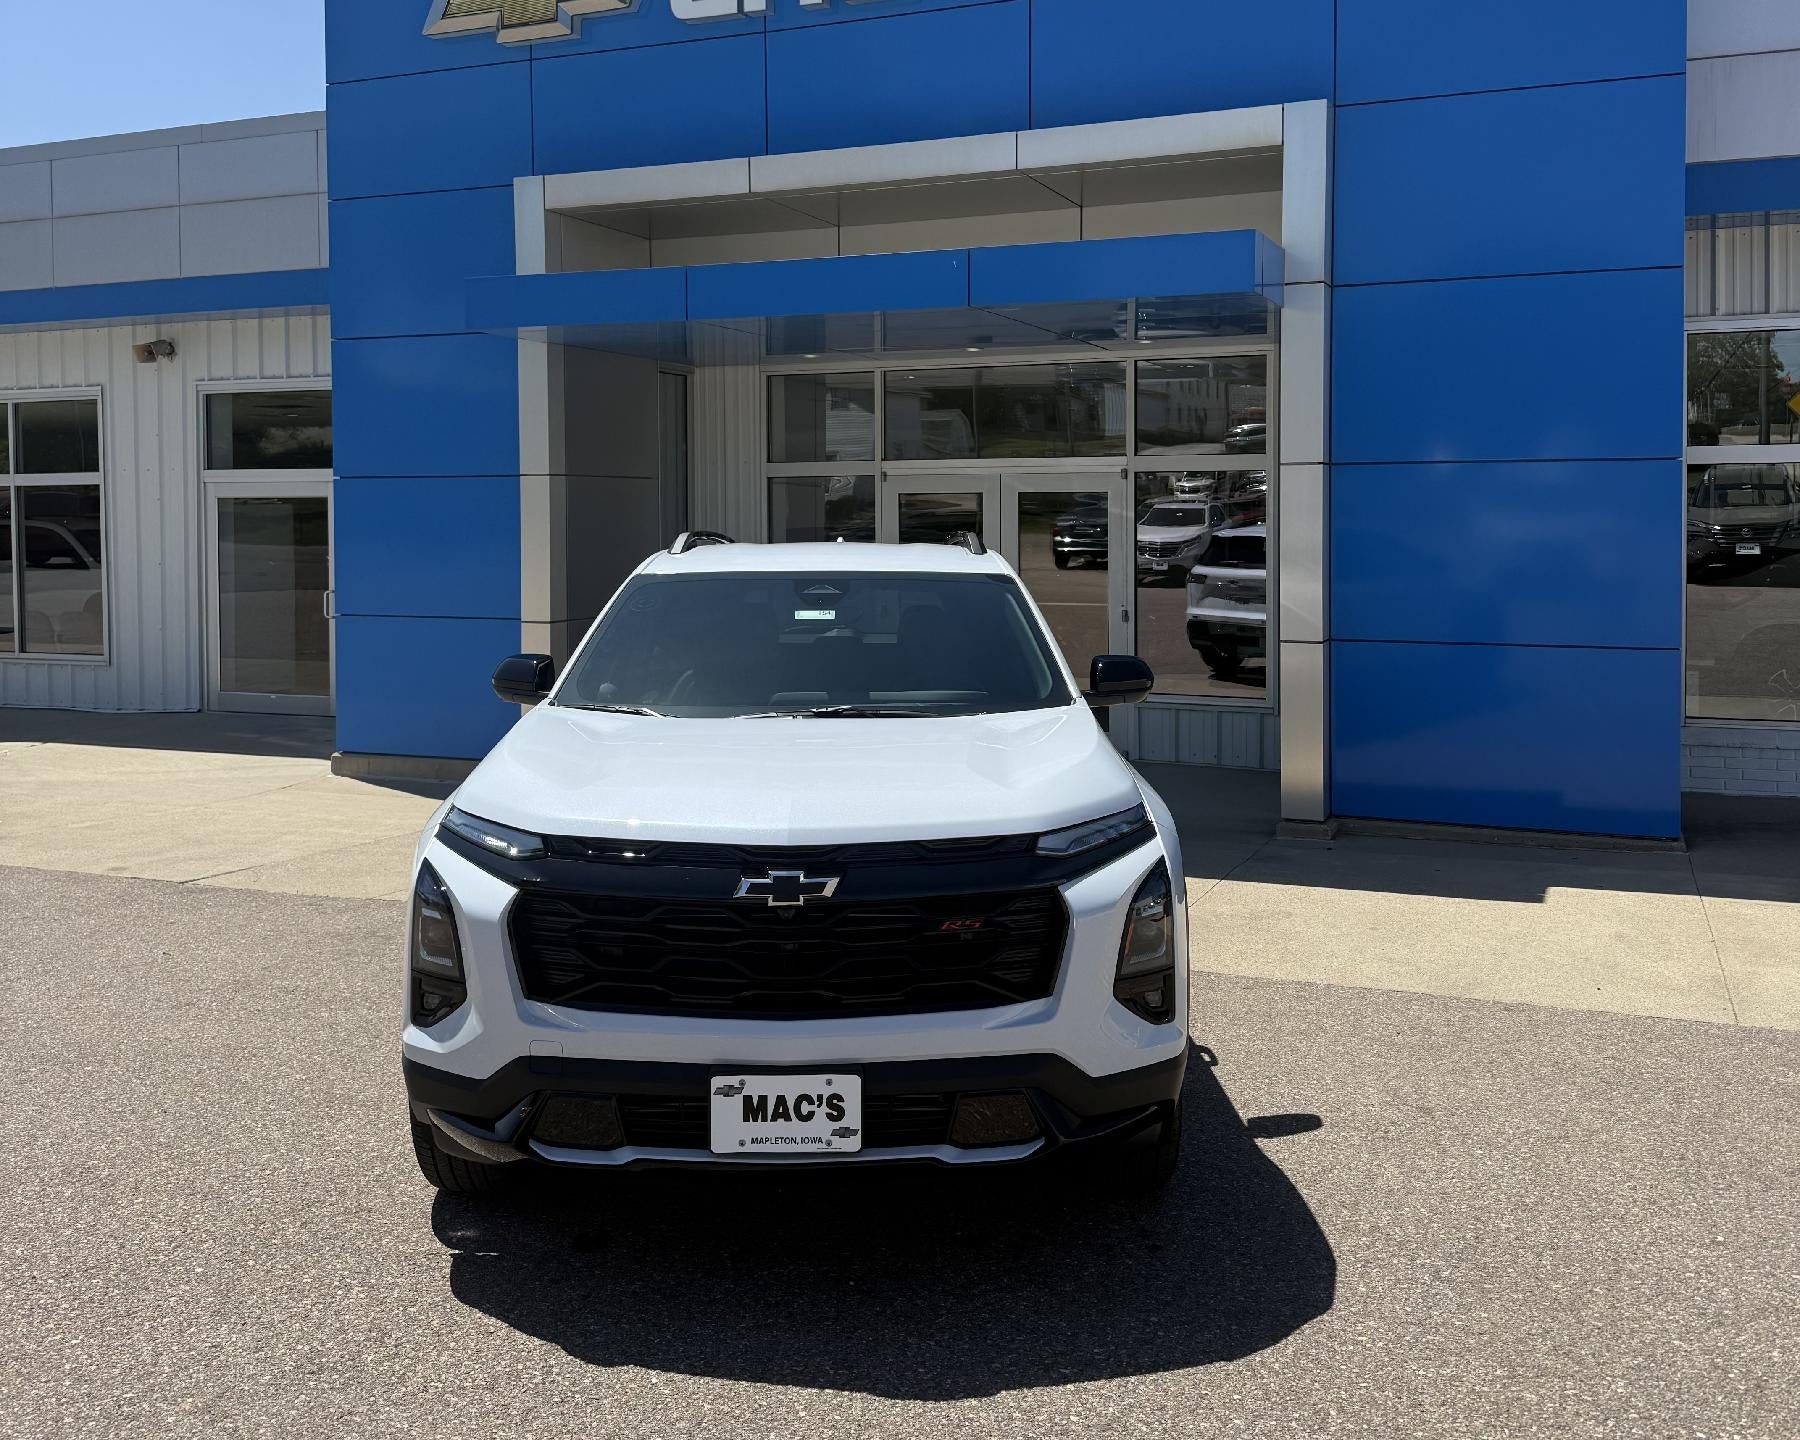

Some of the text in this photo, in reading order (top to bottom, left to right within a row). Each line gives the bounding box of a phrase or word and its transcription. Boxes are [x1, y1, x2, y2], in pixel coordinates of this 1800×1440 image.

[941, 920, 982, 930] RS
[743, 1093, 846, 1122] MAC'S
[750, 1136, 824, 1146] MAPLETON, IOWA
